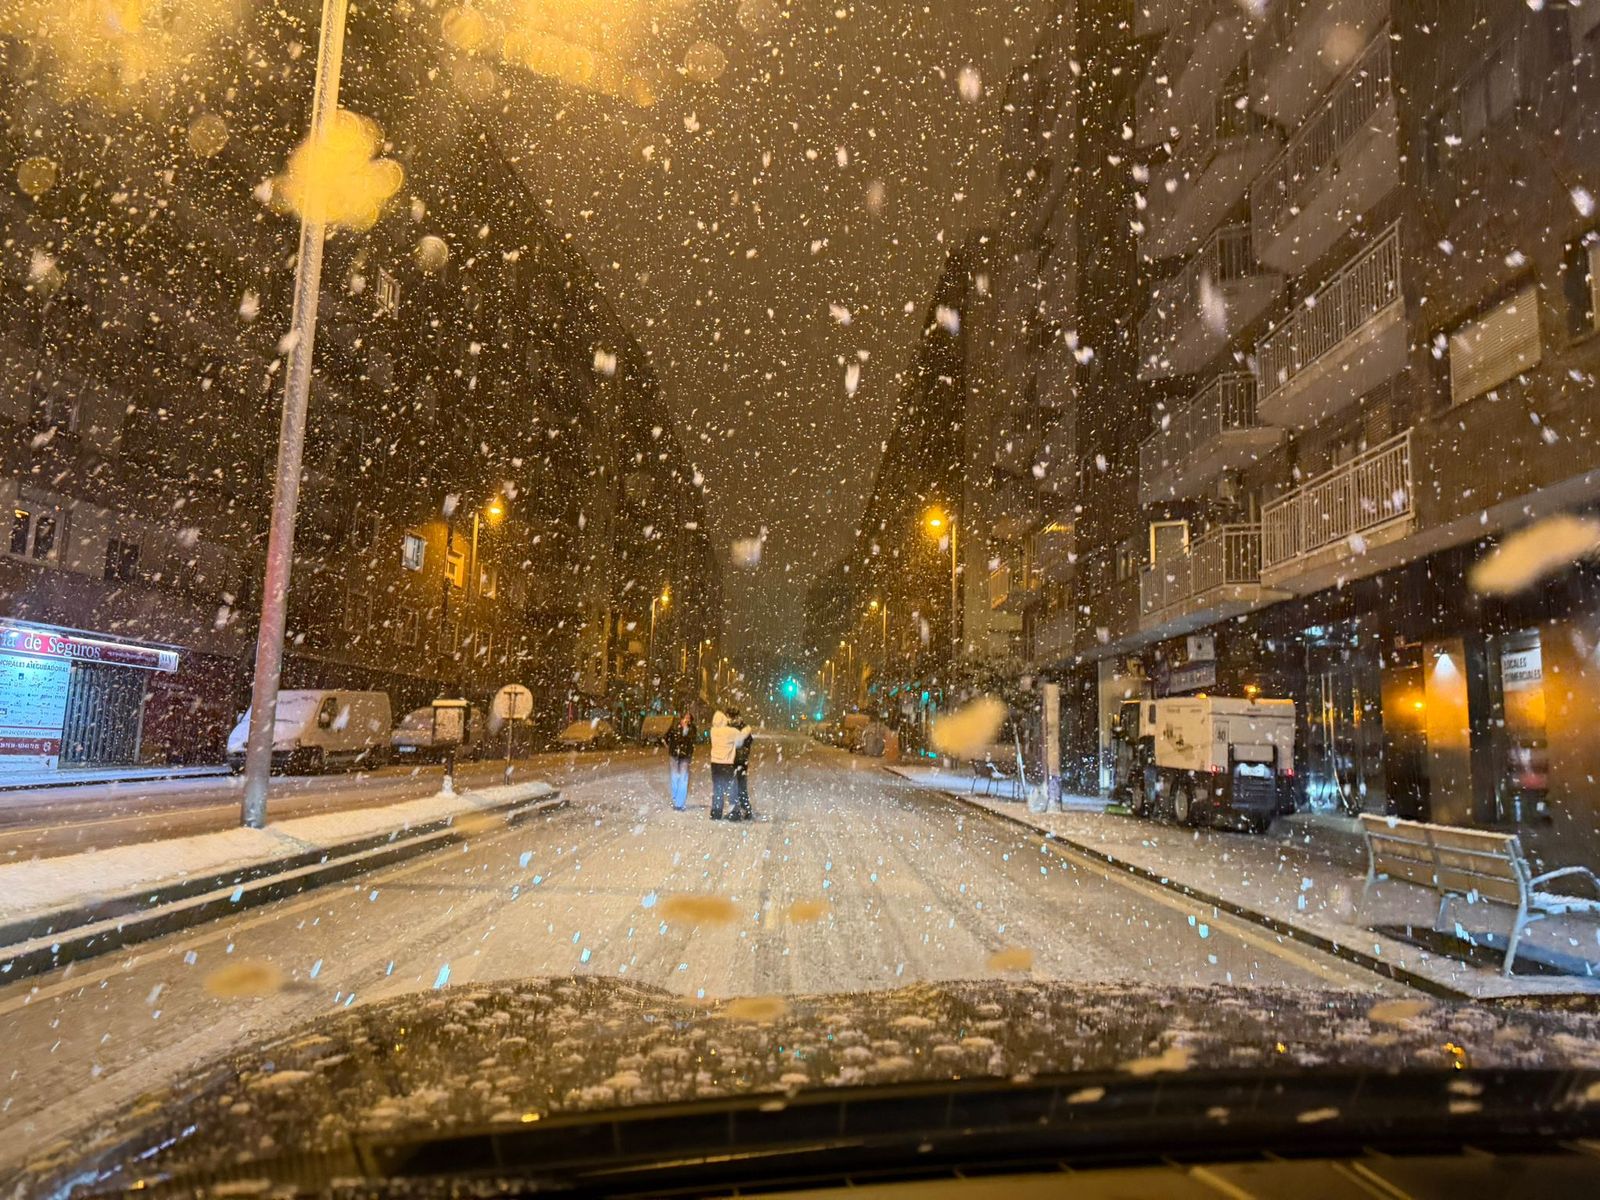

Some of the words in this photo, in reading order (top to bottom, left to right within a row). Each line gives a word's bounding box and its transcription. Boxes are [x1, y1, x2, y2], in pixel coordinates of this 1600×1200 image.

[24, 633, 42, 651] de
[47, 636, 101, 659] Seguros
[1504, 657, 1527, 670] LOCALES
